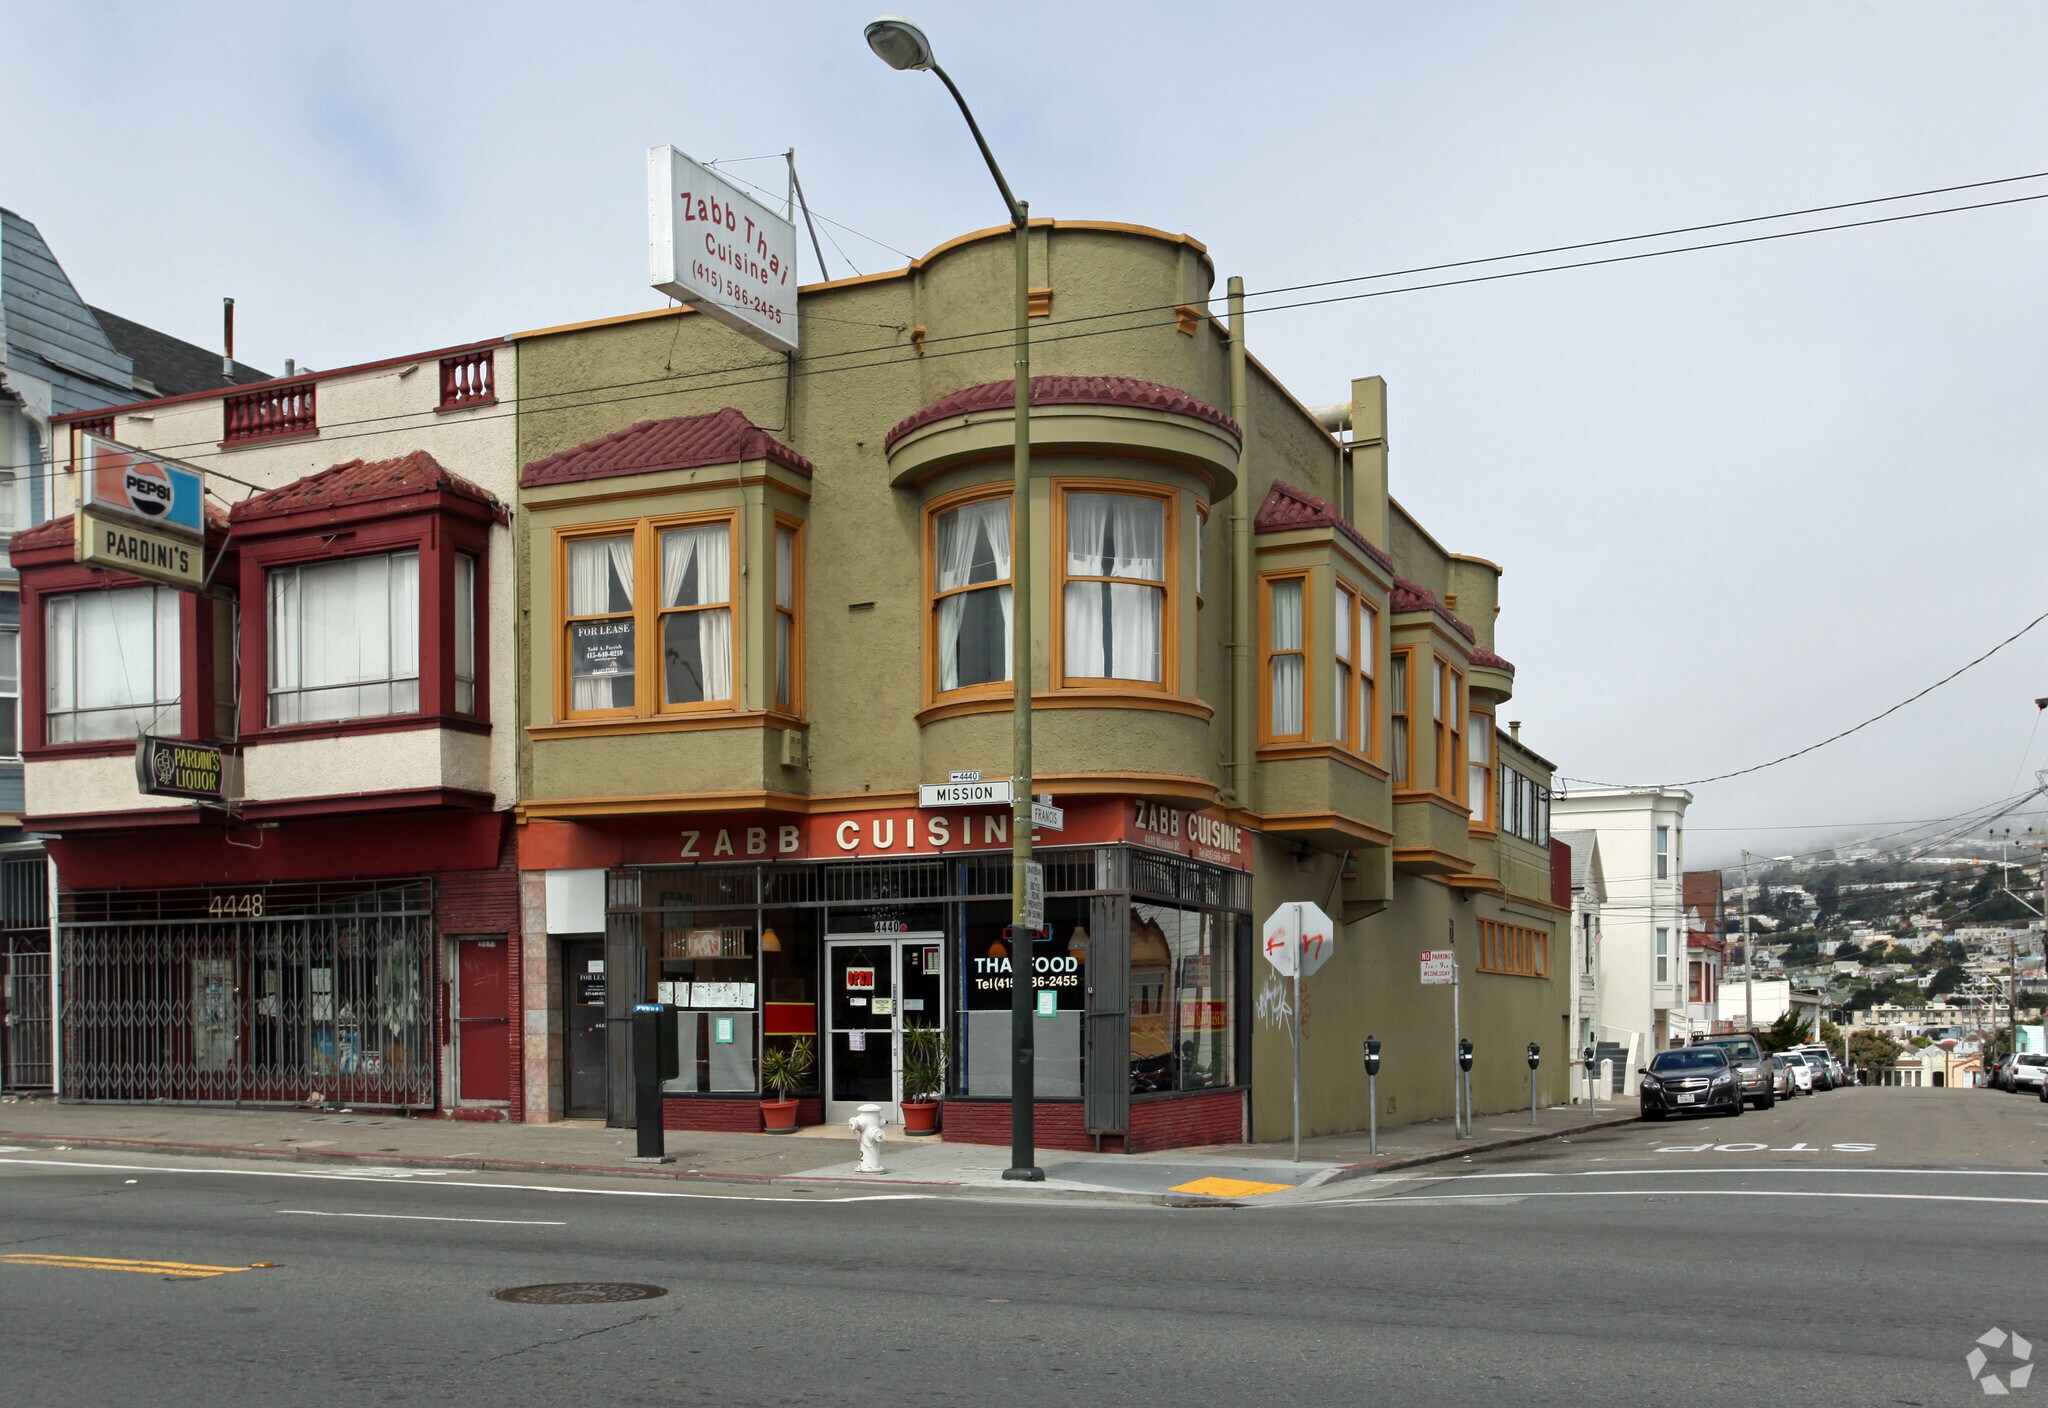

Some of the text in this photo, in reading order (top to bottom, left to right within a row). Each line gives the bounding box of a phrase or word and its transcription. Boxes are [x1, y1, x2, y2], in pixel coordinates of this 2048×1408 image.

[681, 192, 789, 286] Zabb Thai
[705, 232, 768, 284] Cuisine
[692, 260, 782, 324] (415) 586-2455
[126, 474, 170, 501] PEPSI
[107, 530, 188, 573] PARDINI'S
[578, 623, 630, 637] FOR LEASE
[174, 747, 220, 772] PARDINI'S
[175, 768, 216, 791] LIQUOR
[960, 772, 978, 781] 4440
[937, 786, 993, 801] MISSION
[1034, 807, 1058, 825] FRANCIS
[1135, 800, 1242, 854] ZABB CUISINE
[680, 814, 1041, 858] ZABB CUISIN
[209, 894, 263, 918] 4448
[875, 921, 899, 933] 4440
[974, 957, 1013, 973] THA
[1421, 952, 1430, 961] NO
[847, 970, 873, 987] OPEN
[1653, 1142, 1878, 1153] STOP
